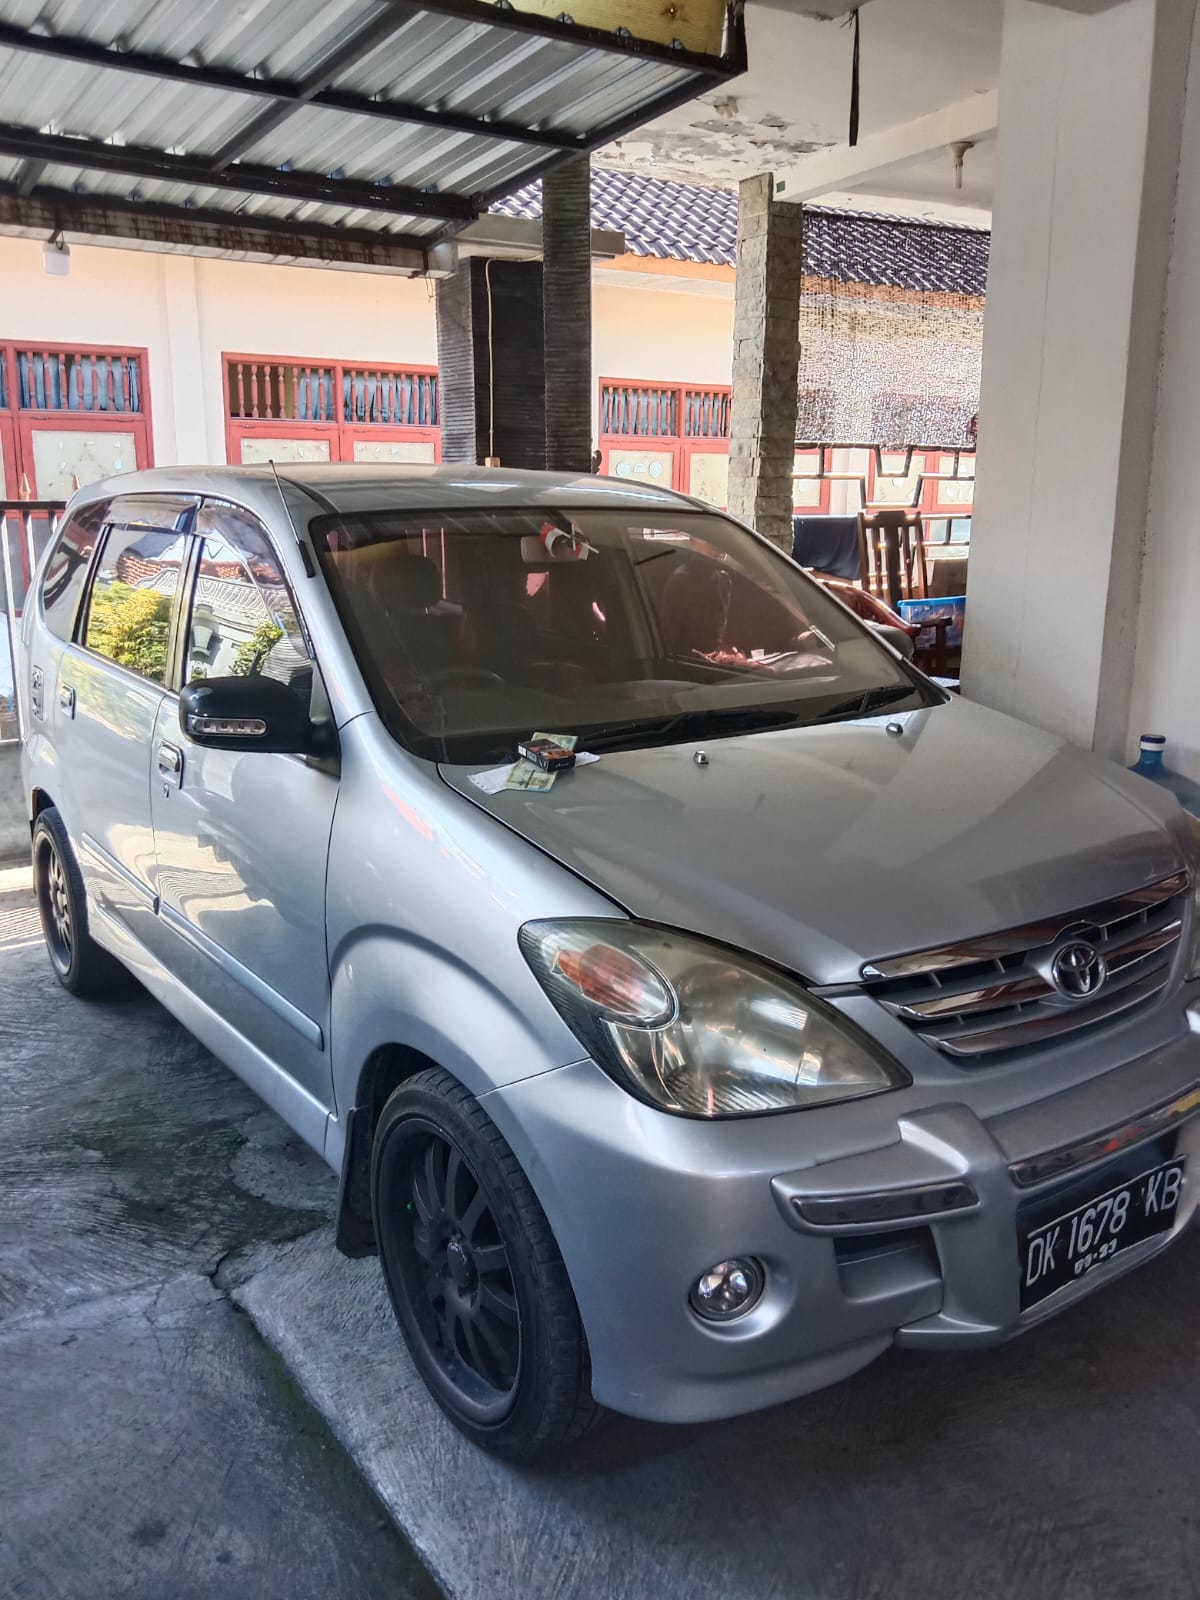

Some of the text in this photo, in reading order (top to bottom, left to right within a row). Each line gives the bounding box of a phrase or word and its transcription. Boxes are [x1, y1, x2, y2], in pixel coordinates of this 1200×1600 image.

[1026, 1167, 1182, 1287] DK 1678 KB
